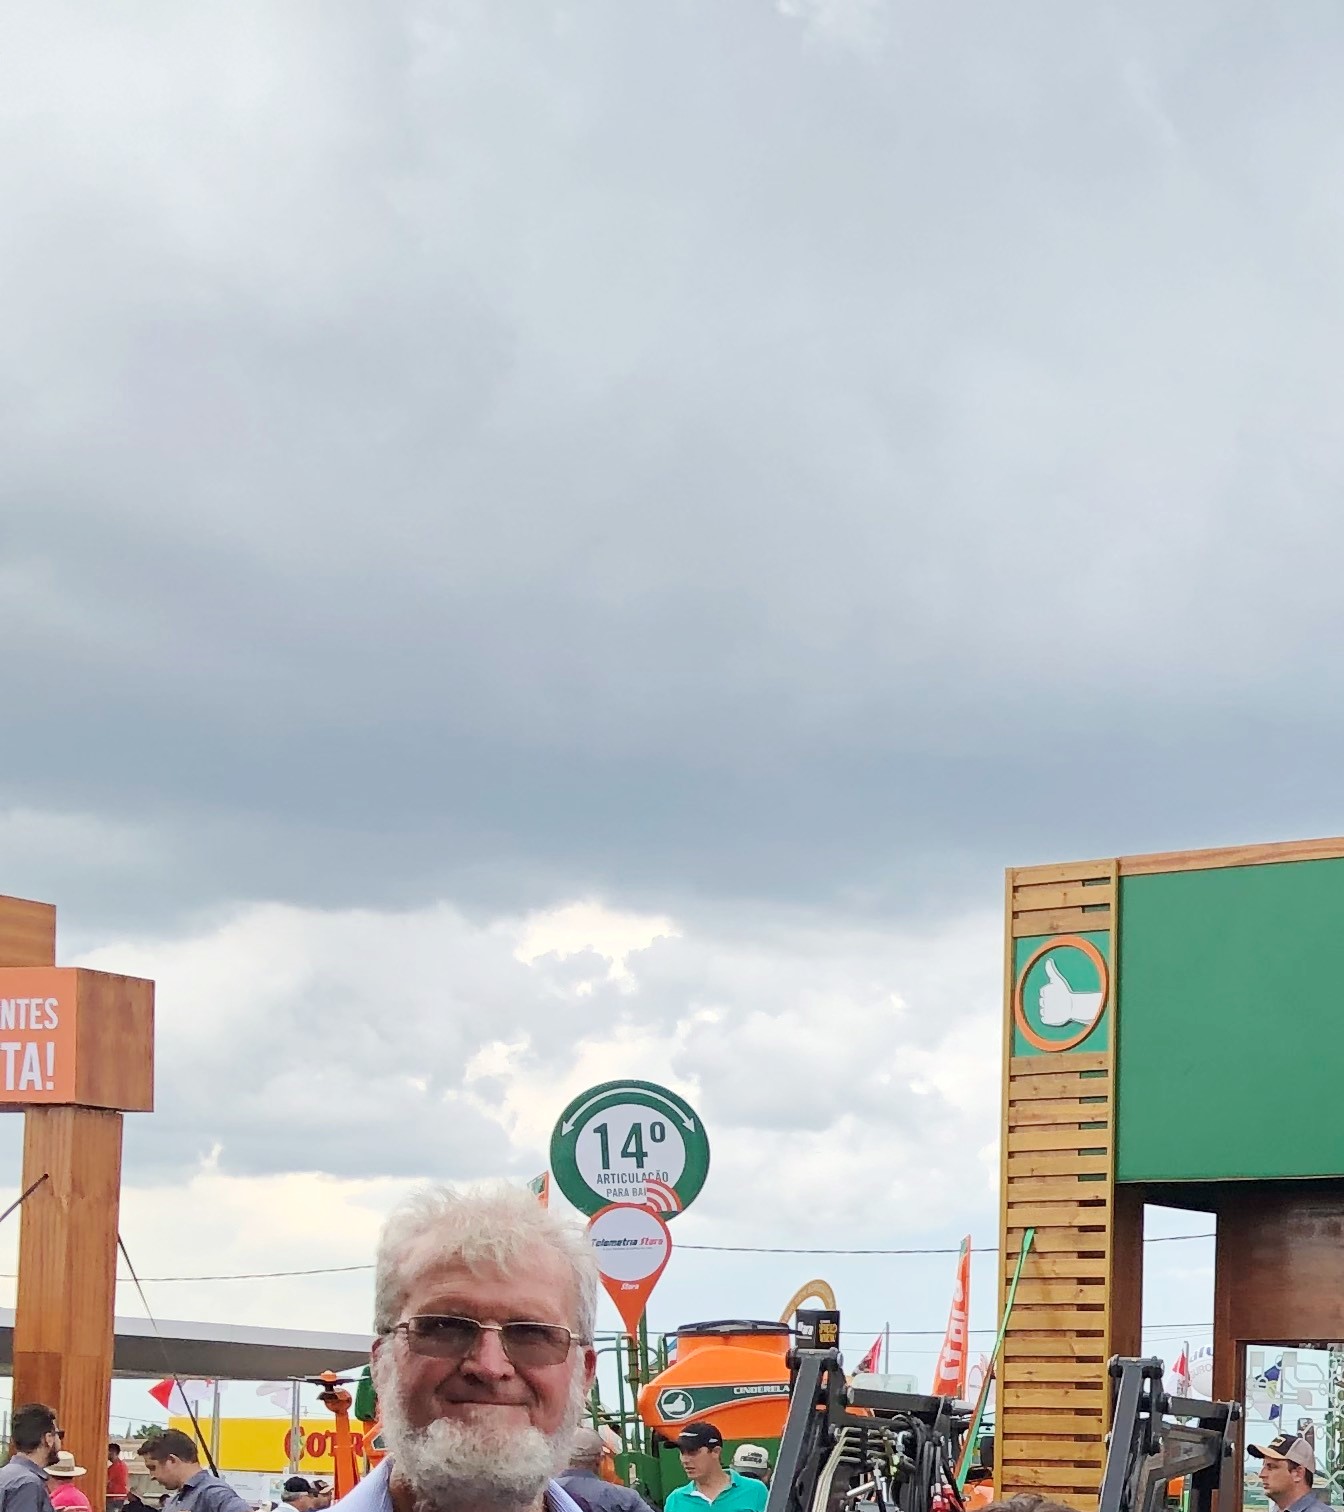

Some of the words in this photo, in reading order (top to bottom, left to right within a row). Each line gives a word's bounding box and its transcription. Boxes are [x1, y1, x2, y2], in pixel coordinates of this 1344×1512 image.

[0, 1041, 56, 1091] TA!
[596, 1169, 670, 1185] ARTICULAÇÃO
[606, 1187, 631, 1198] PARA
[591, 1237, 639, 1247] Telemetria
